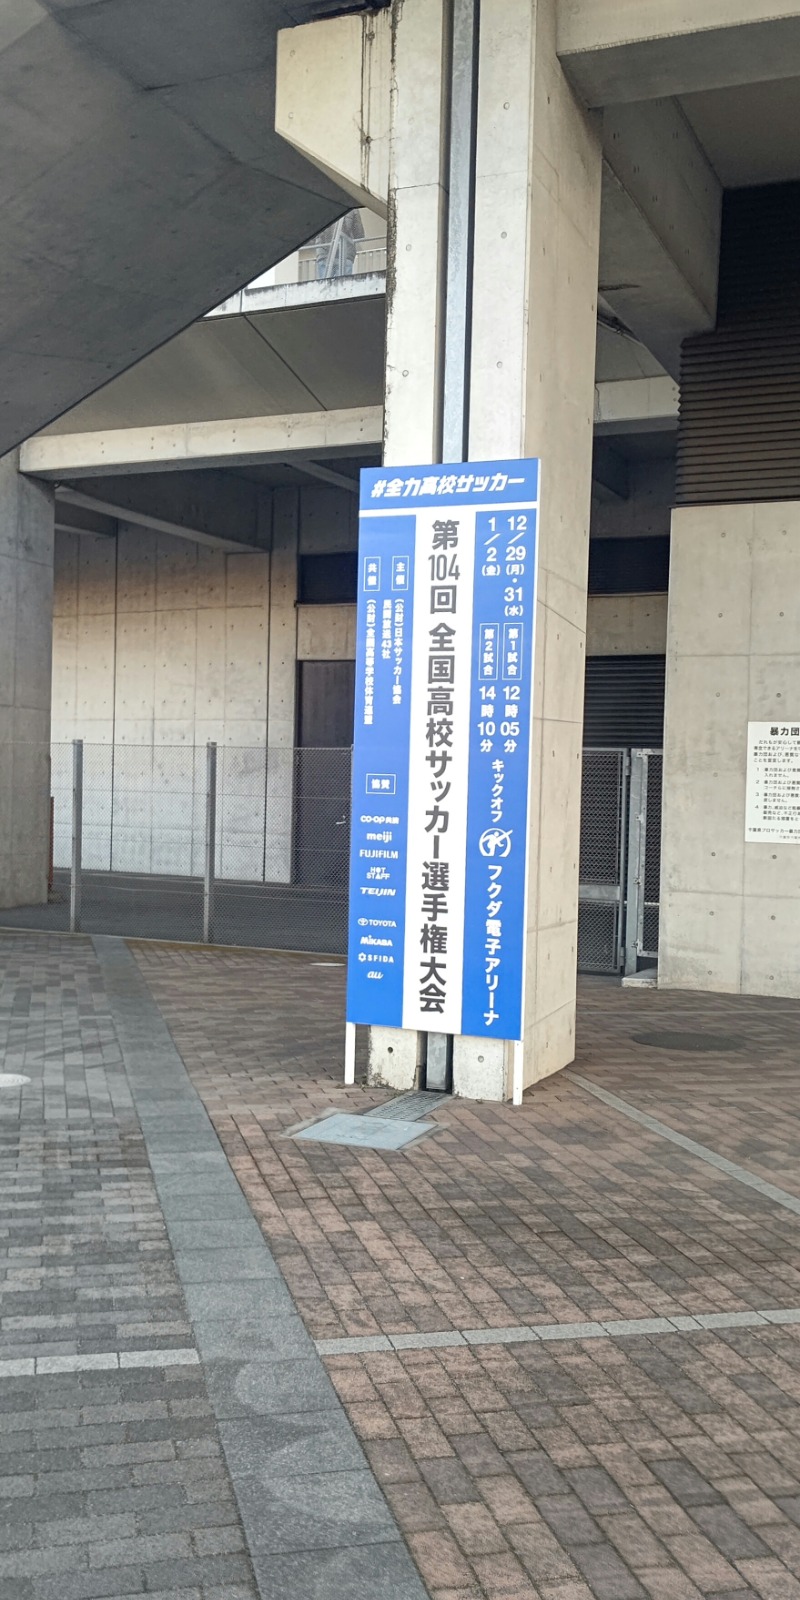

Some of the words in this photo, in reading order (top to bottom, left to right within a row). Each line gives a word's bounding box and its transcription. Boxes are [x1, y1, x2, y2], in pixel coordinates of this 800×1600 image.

[371, 473, 525, 498] #全力高校サッカー
[428, 519, 461, 614] 第104回
[483, 629, 495, 676] 第2試合
[507, 628, 519, 676] 第1試合
[490, 759, 505, 823] キックオフ
[419, 622, 457, 1014] 全国高校サッカー選手権大会
[366, 831, 392, 843] meiji
[359, 849, 398, 859] FUJIFILM
[359, 887, 396, 896] TEIJIN
[368, 919, 397, 927] TOYOTA
[483, 865, 503, 1026] フクダ電子アリーナ
[367, 954, 394, 963] SFIDA
[367, 970, 383, 979] au
